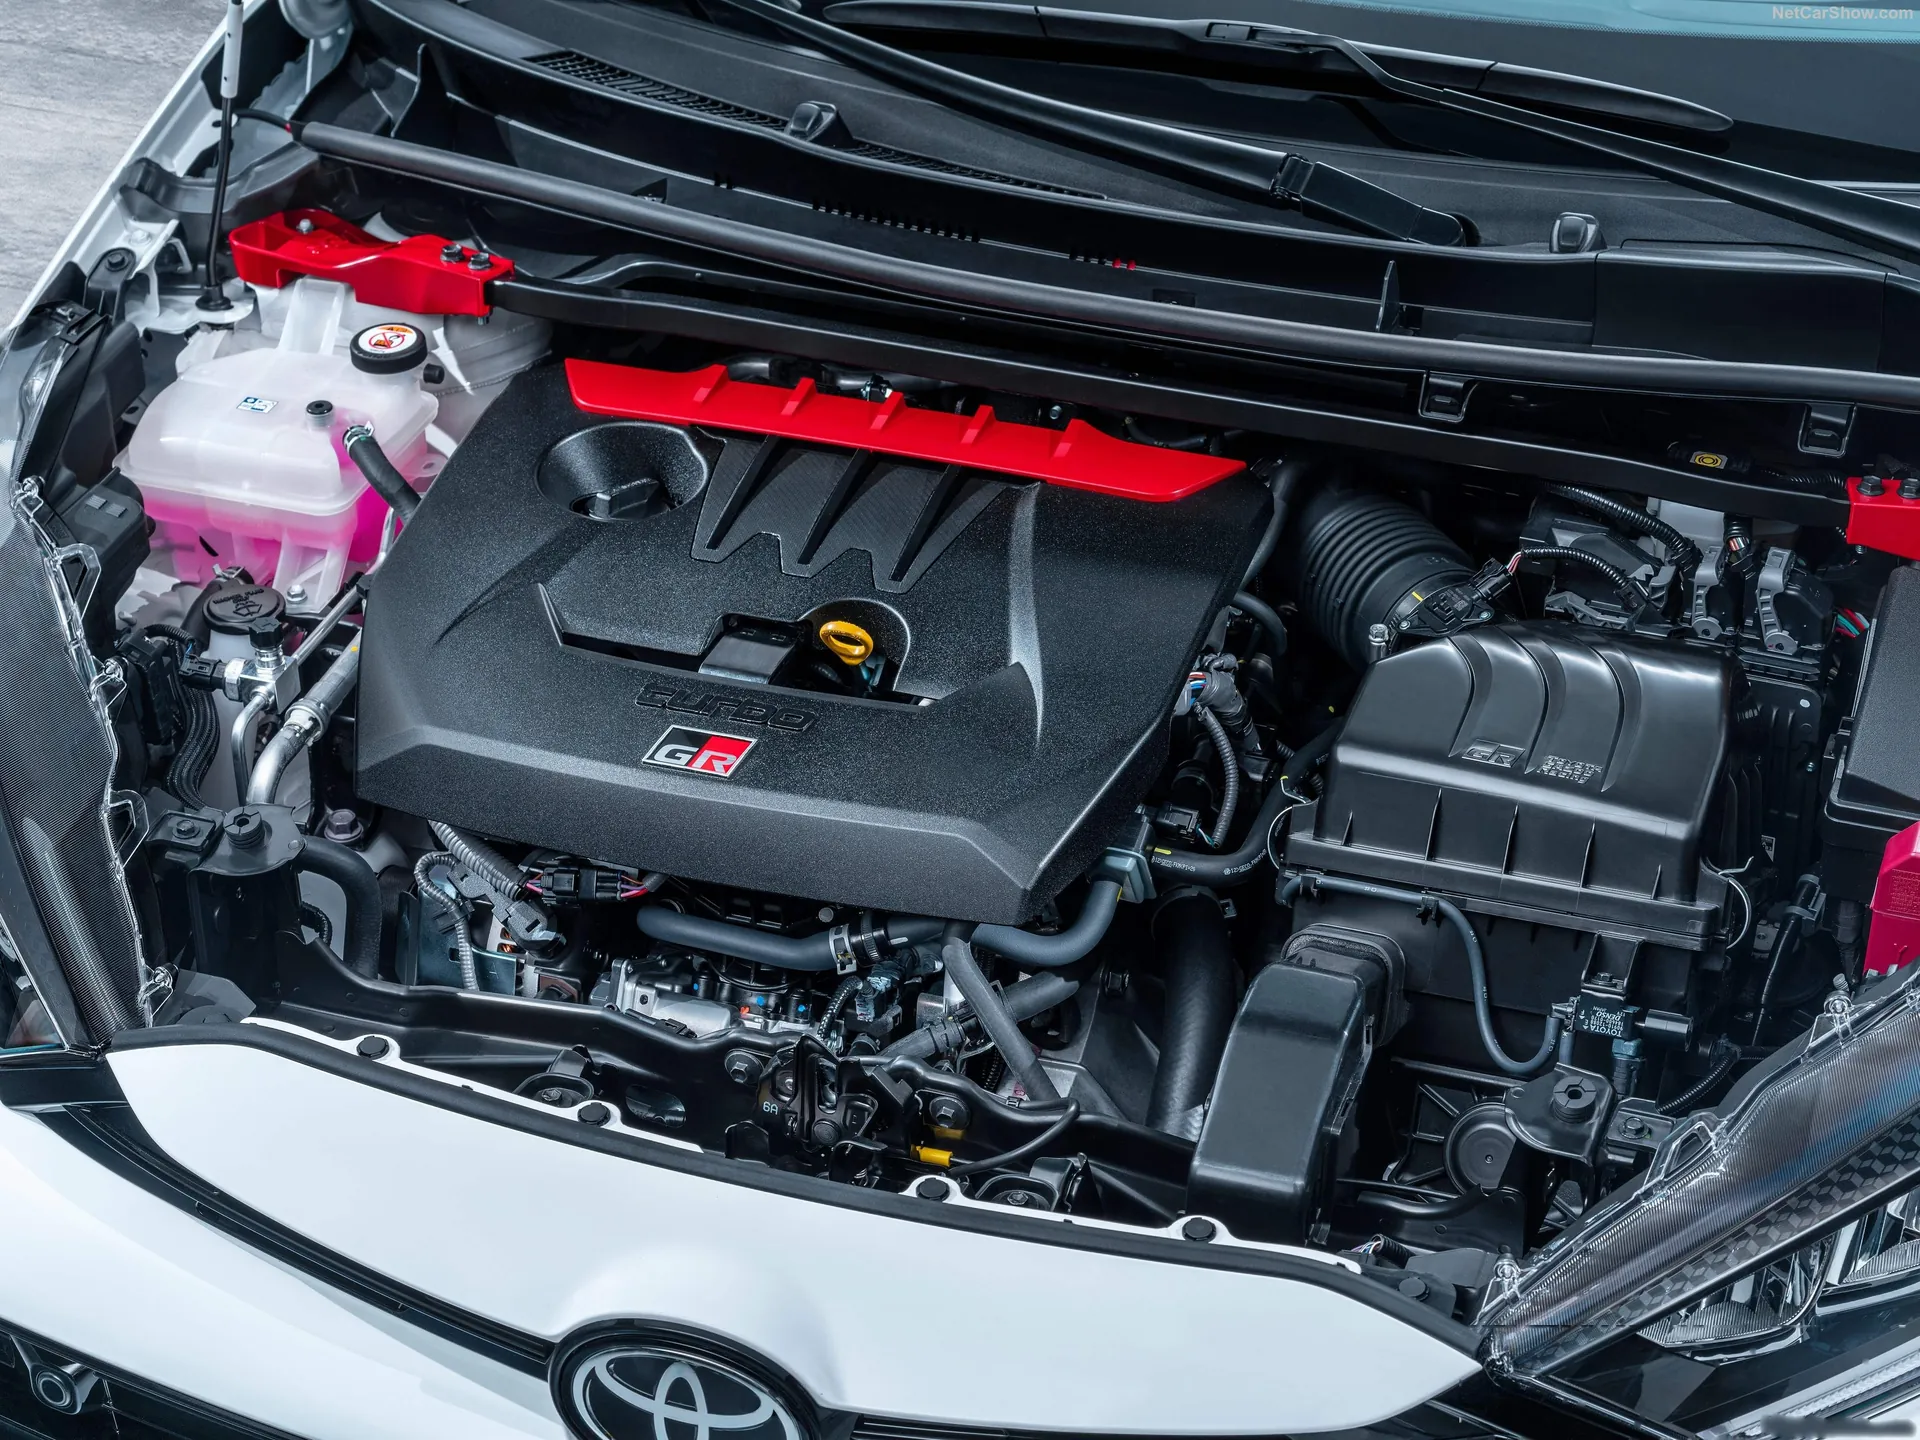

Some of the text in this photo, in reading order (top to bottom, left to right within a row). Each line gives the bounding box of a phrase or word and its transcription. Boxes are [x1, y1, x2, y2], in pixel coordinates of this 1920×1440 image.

[653, 743, 737, 773] GR
[1465, 747, 1516, 768] GR
[1596, 1011, 1620, 1021] DENSO
[1590, 1024, 1622, 1037] TOYOTA
[763, 1101, 778, 1115] 6A
